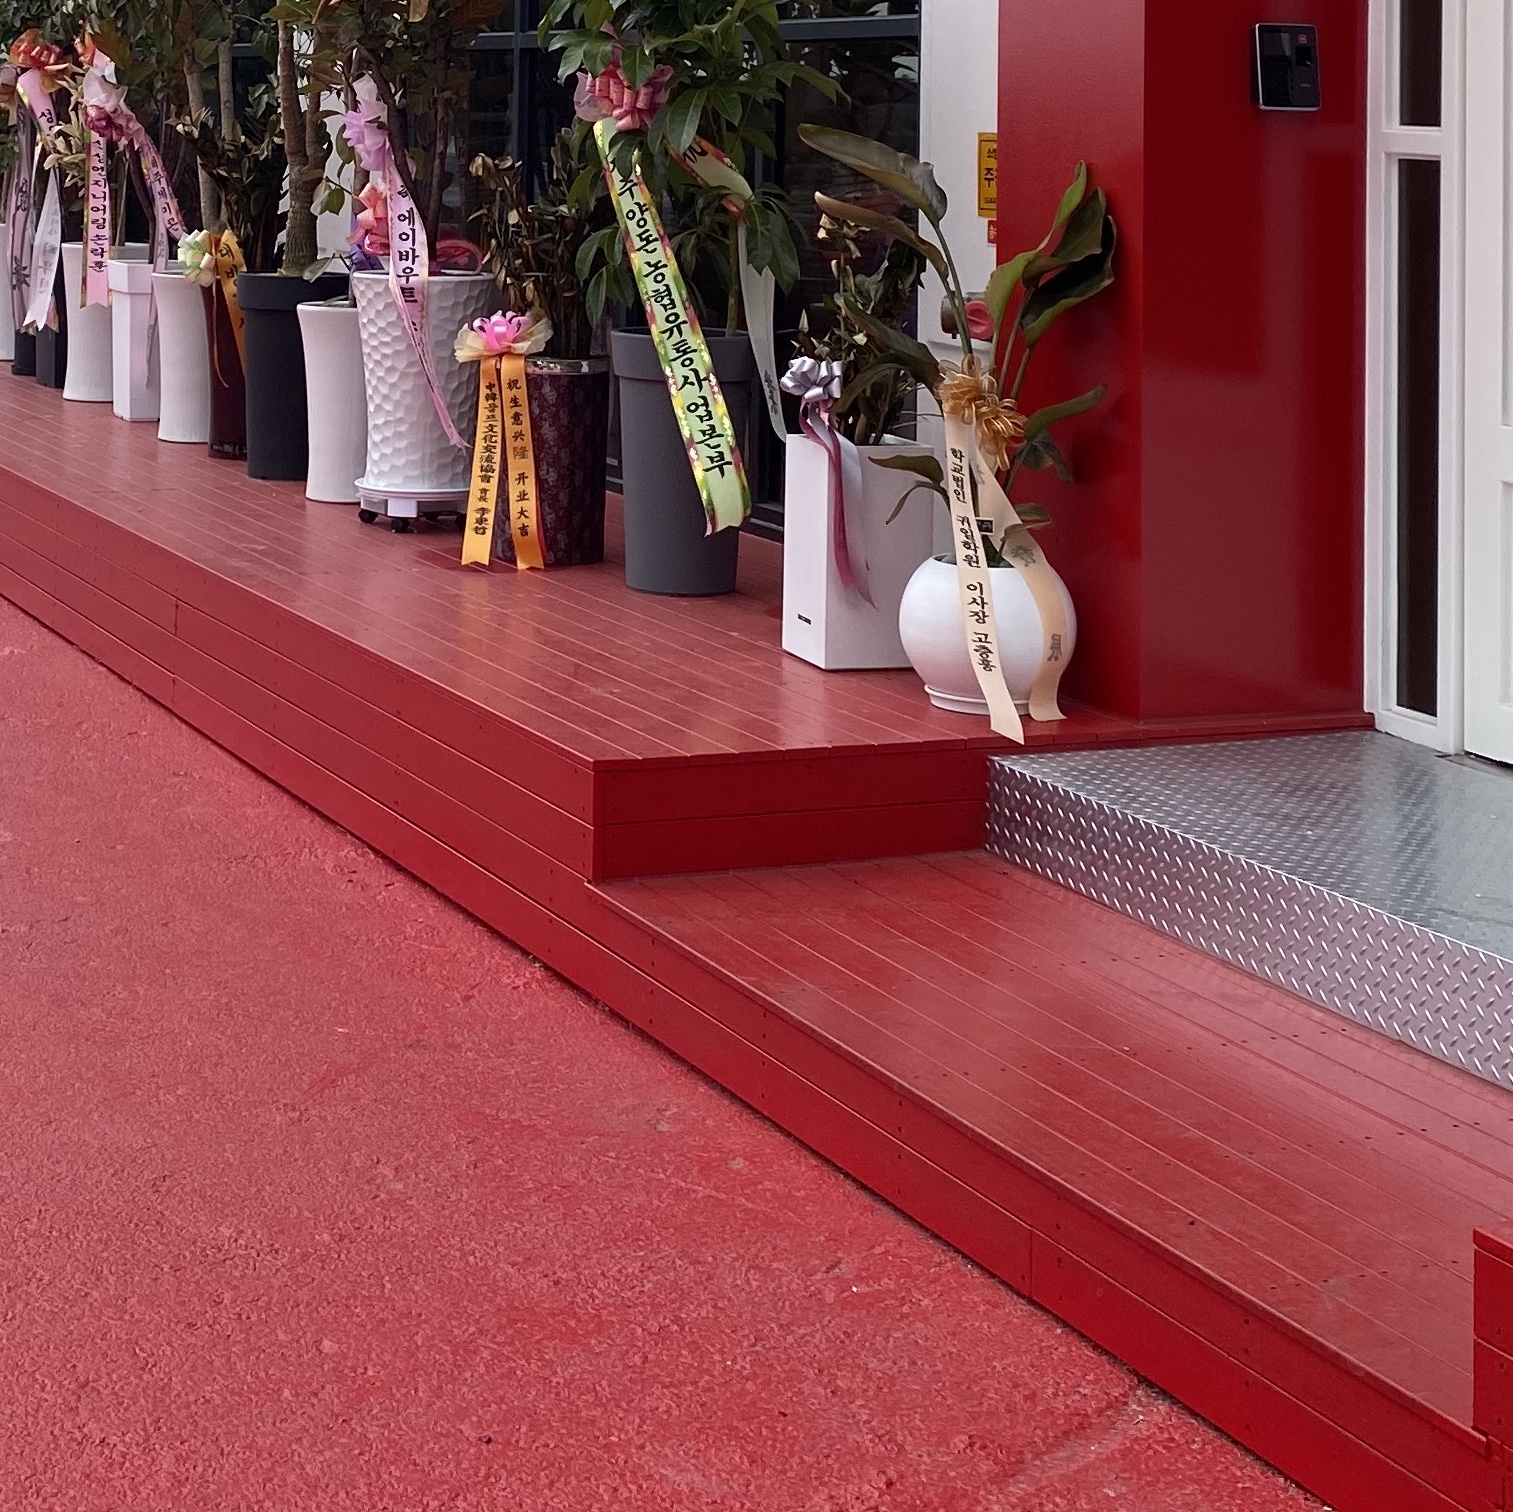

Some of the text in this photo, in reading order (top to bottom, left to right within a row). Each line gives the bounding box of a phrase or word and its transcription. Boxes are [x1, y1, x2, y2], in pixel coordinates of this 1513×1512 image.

[396, 206, 420, 303] 에이바우트
[506, 377, 531, 538] 祝生意兴隆 开业大吉
[949, 447, 968, 504] 학교법인
[966, 581, 990, 624] 이사장
